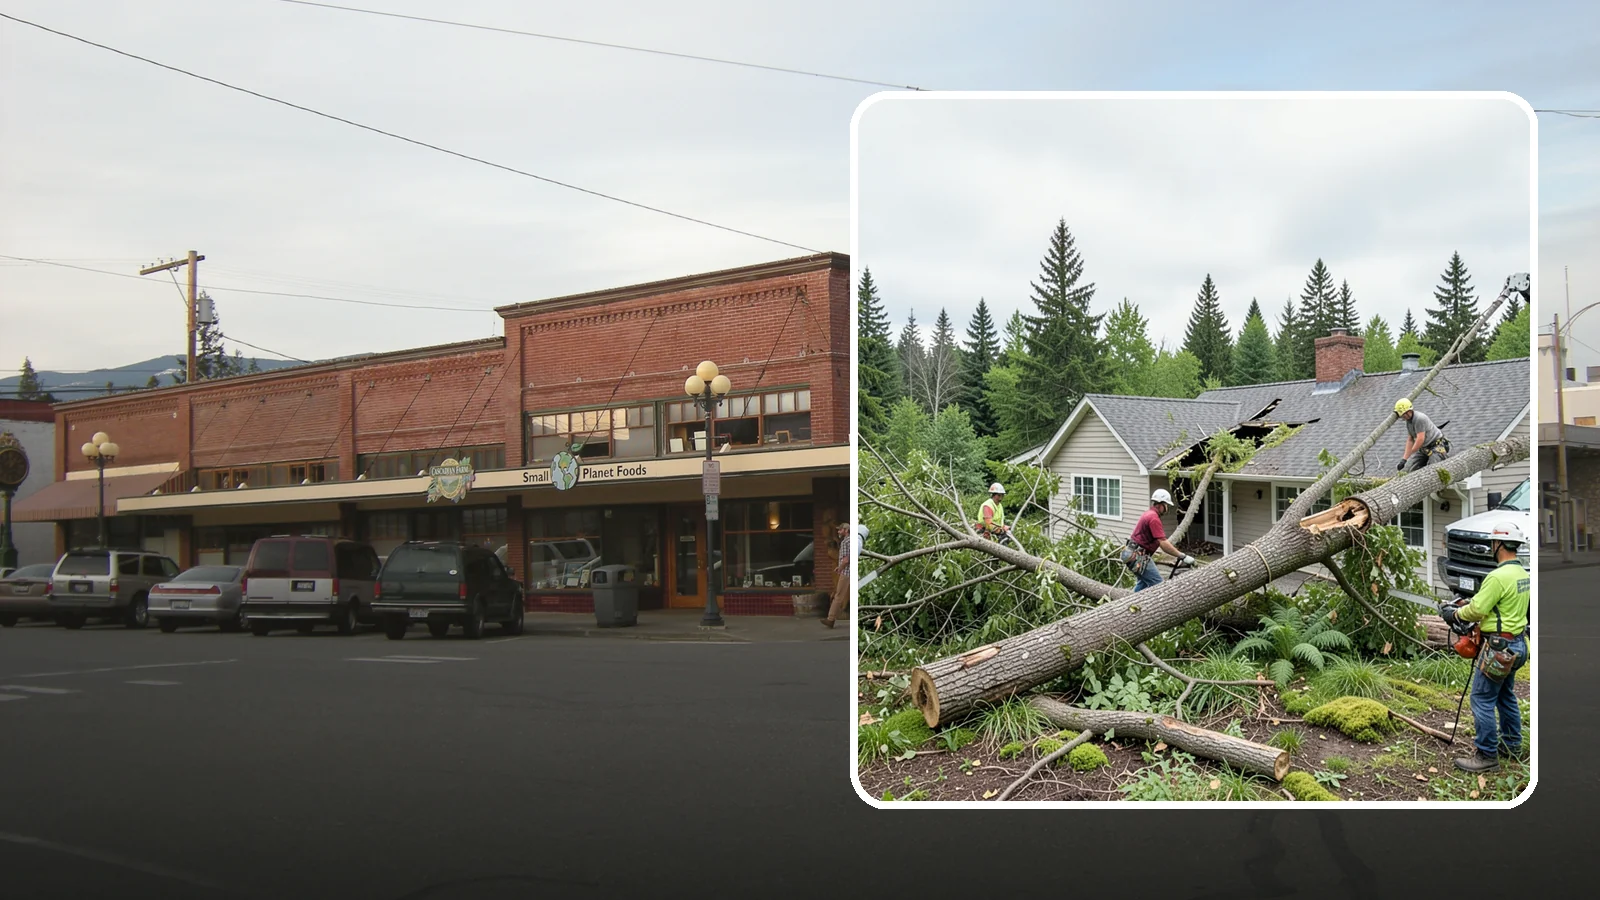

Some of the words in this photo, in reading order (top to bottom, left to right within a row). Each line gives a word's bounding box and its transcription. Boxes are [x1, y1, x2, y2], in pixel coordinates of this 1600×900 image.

[523, 470, 549, 483] Small
[583, 467, 614, 480] Planet
[617, 464, 647, 477] Foods
